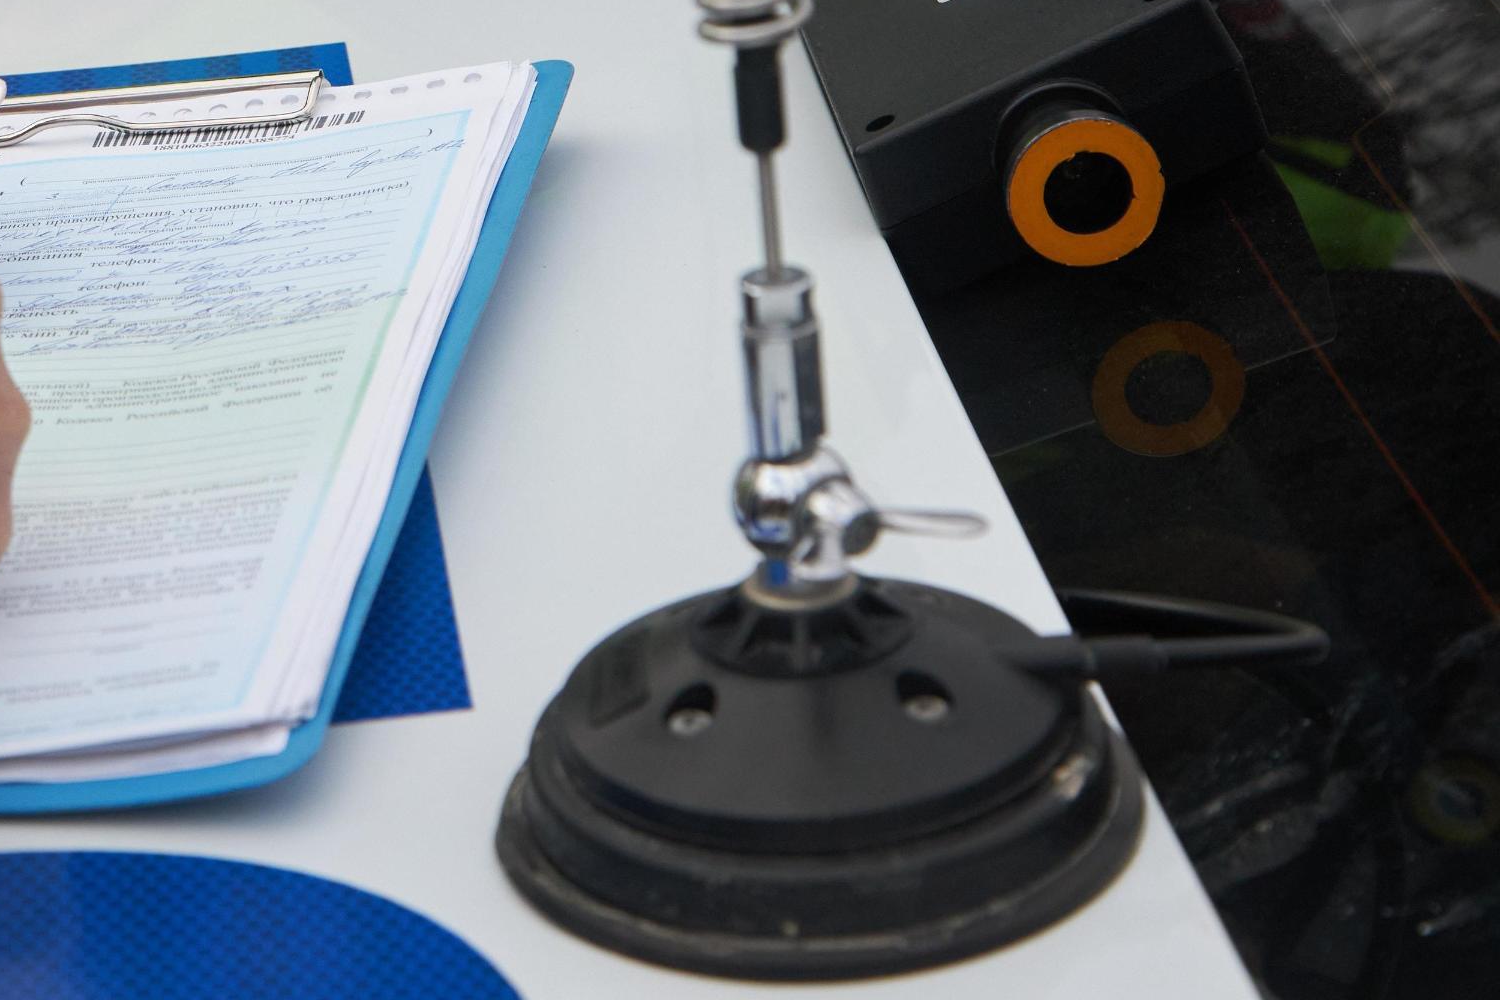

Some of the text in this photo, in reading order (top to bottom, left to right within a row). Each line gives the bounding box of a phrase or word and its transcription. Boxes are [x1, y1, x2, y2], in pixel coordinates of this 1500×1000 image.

[46, 210, 174, 231] правонарушения,
[268, 198, 294, 208] что
[299, 180, 410, 206] гражданин(ка)
[90, 257, 162, 268] телефон:
[77, 280, 151, 292] телефон:
